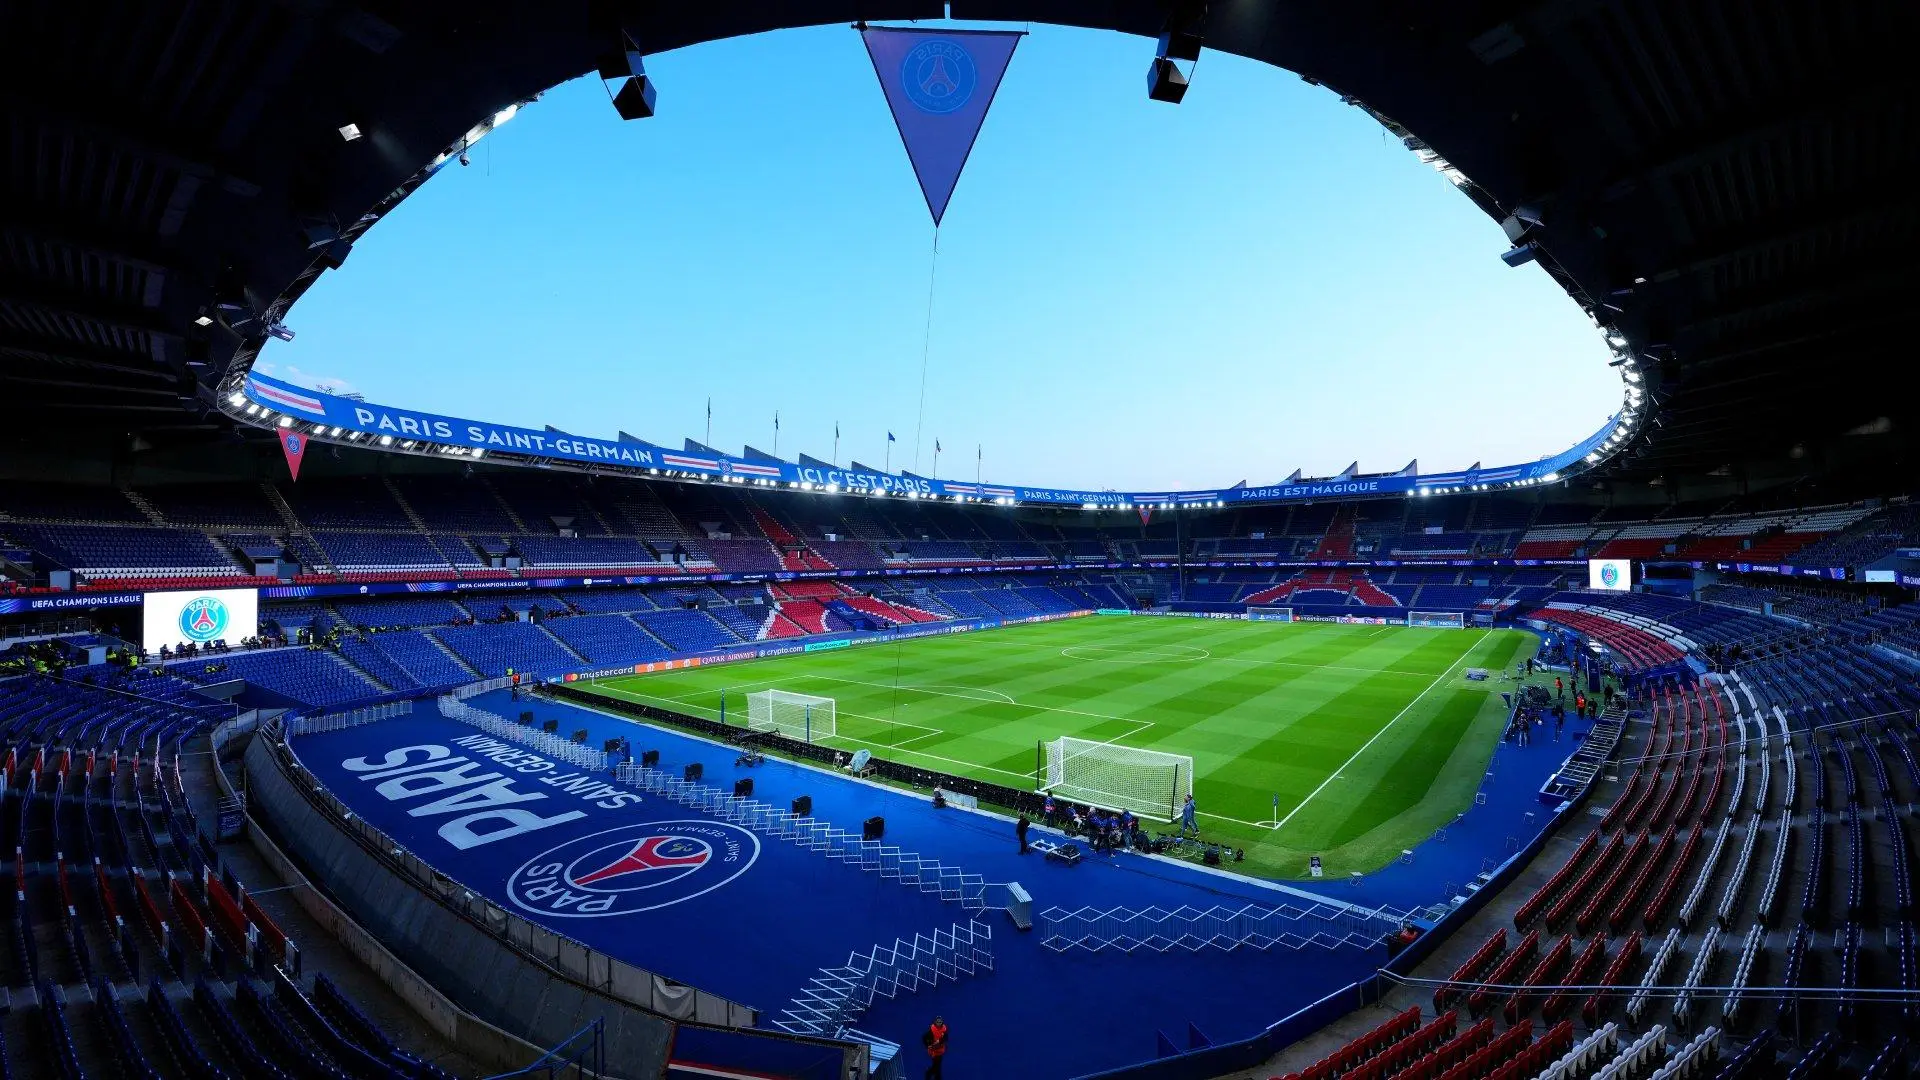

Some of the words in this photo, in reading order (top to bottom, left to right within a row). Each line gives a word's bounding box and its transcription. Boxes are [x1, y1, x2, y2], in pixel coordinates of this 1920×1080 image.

[354, 407, 453, 438] PARIS
[467, 426, 653, 464] SAINT-GERMAIN
[797, 467, 823, 484] ICI
[827, 470, 876, 489] C'EST
[881, 476, 931, 492] PARIS
[1023, 490, 1051, 500] PARIS
[1054, 492, 1125, 502] SAINT-GERMAIN
[1241, 488, 1280, 499] PARIS
[1284, 486, 1309, 496] EST
[1312, 481, 1378, 494] MAGIQUE
[32, 600, 54, 608] UEFA
[56, 597, 107, 607] CHAMPIONS
[109, 595, 140, 604] LEAGUE
[951, 625, 968, 633] PEPSI
[702, 655, 725, 664] QATAR
[727, 651, 754, 660] AIRWAYS
[767, 646, 803, 656] crypto.com
[580, 666, 633, 679] mastercard
[451, 734, 643, 809] SAINT-GERMAIN
[341, 744, 588, 850] PARIS
[521, 862, 618, 912] PARIS
